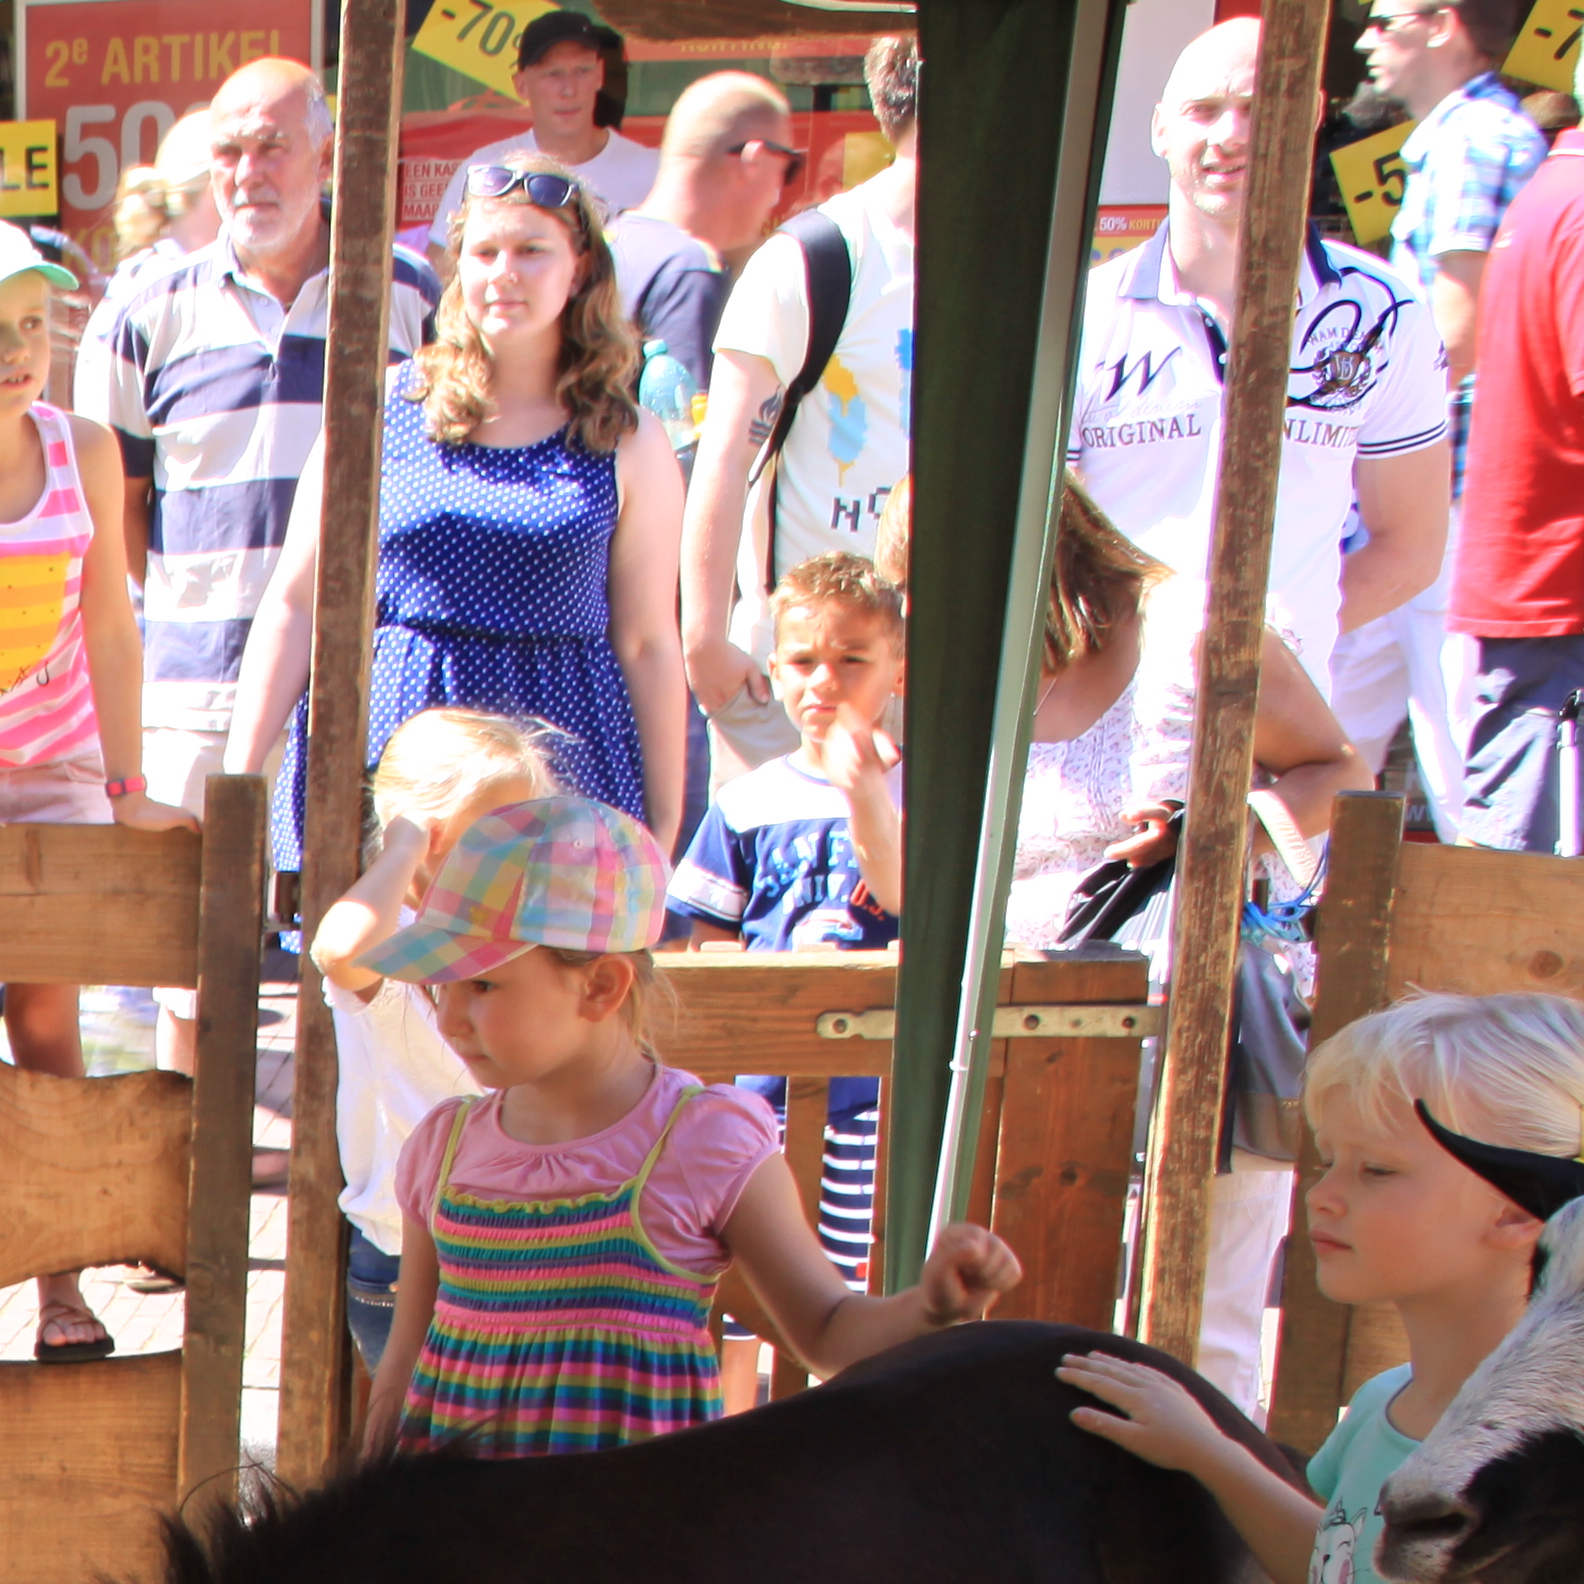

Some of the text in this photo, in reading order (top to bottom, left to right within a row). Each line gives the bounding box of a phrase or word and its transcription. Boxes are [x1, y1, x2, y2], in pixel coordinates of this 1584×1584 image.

[1533, 8, 1584, 61] -7
[420, 182, 448, 198] GEE
[1353, 151, 1406, 208] -5
[1098, 216, 1128, 232] 50%
[1081, 412, 1202, 449] ORIGINAL
